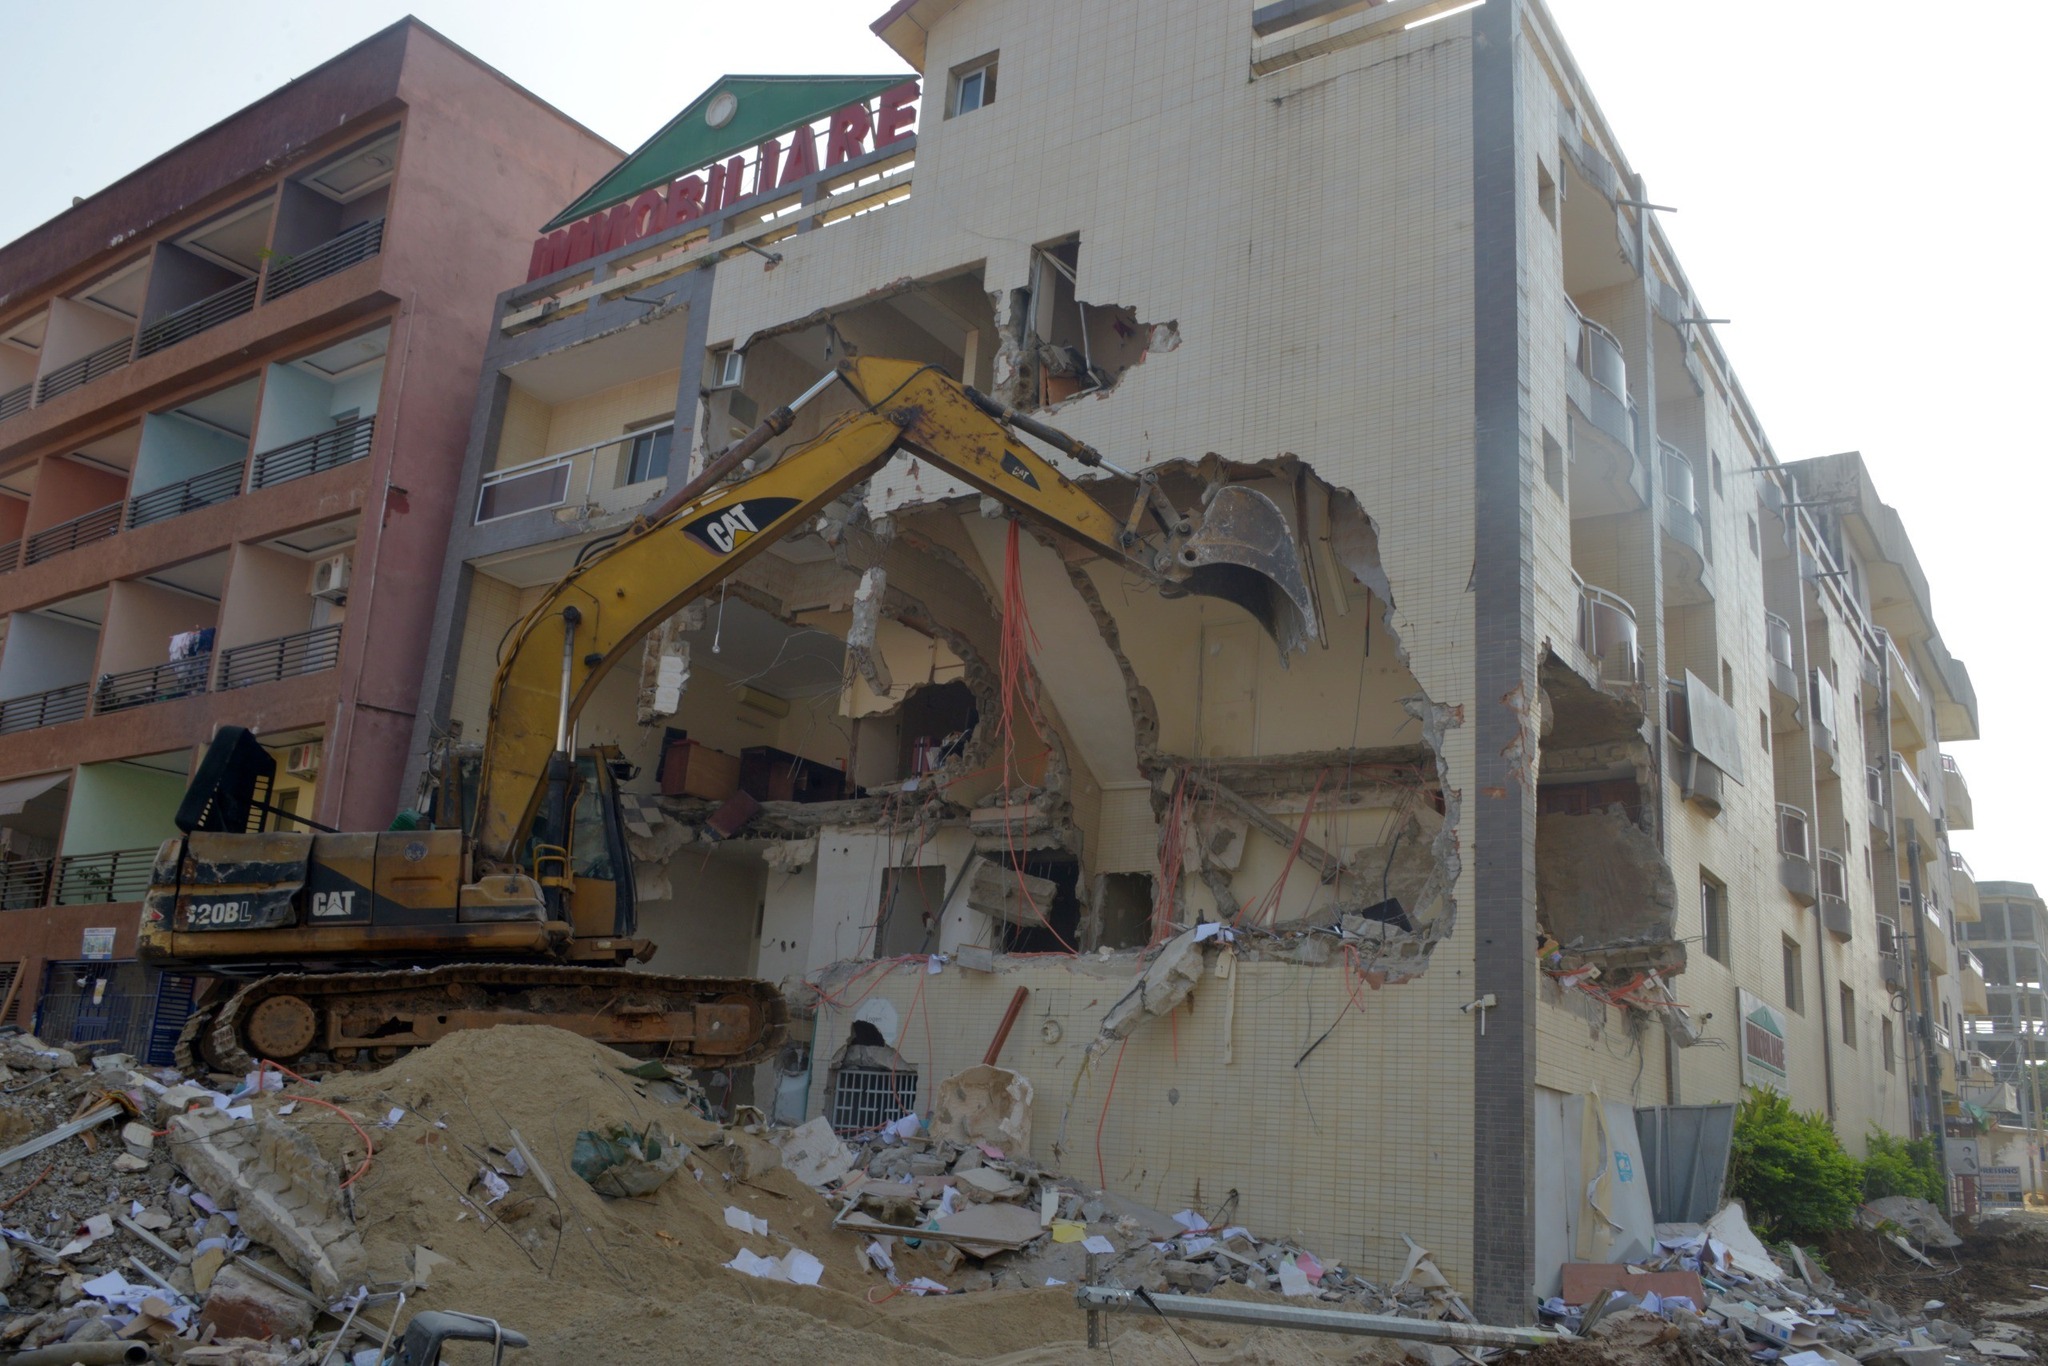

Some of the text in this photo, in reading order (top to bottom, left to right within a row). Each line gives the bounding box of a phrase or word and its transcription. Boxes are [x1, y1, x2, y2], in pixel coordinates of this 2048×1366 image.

[1012, 466, 1029, 480] CAT
[707, 503, 758, 552] CAT
[312, 891, 355, 916] CAT
